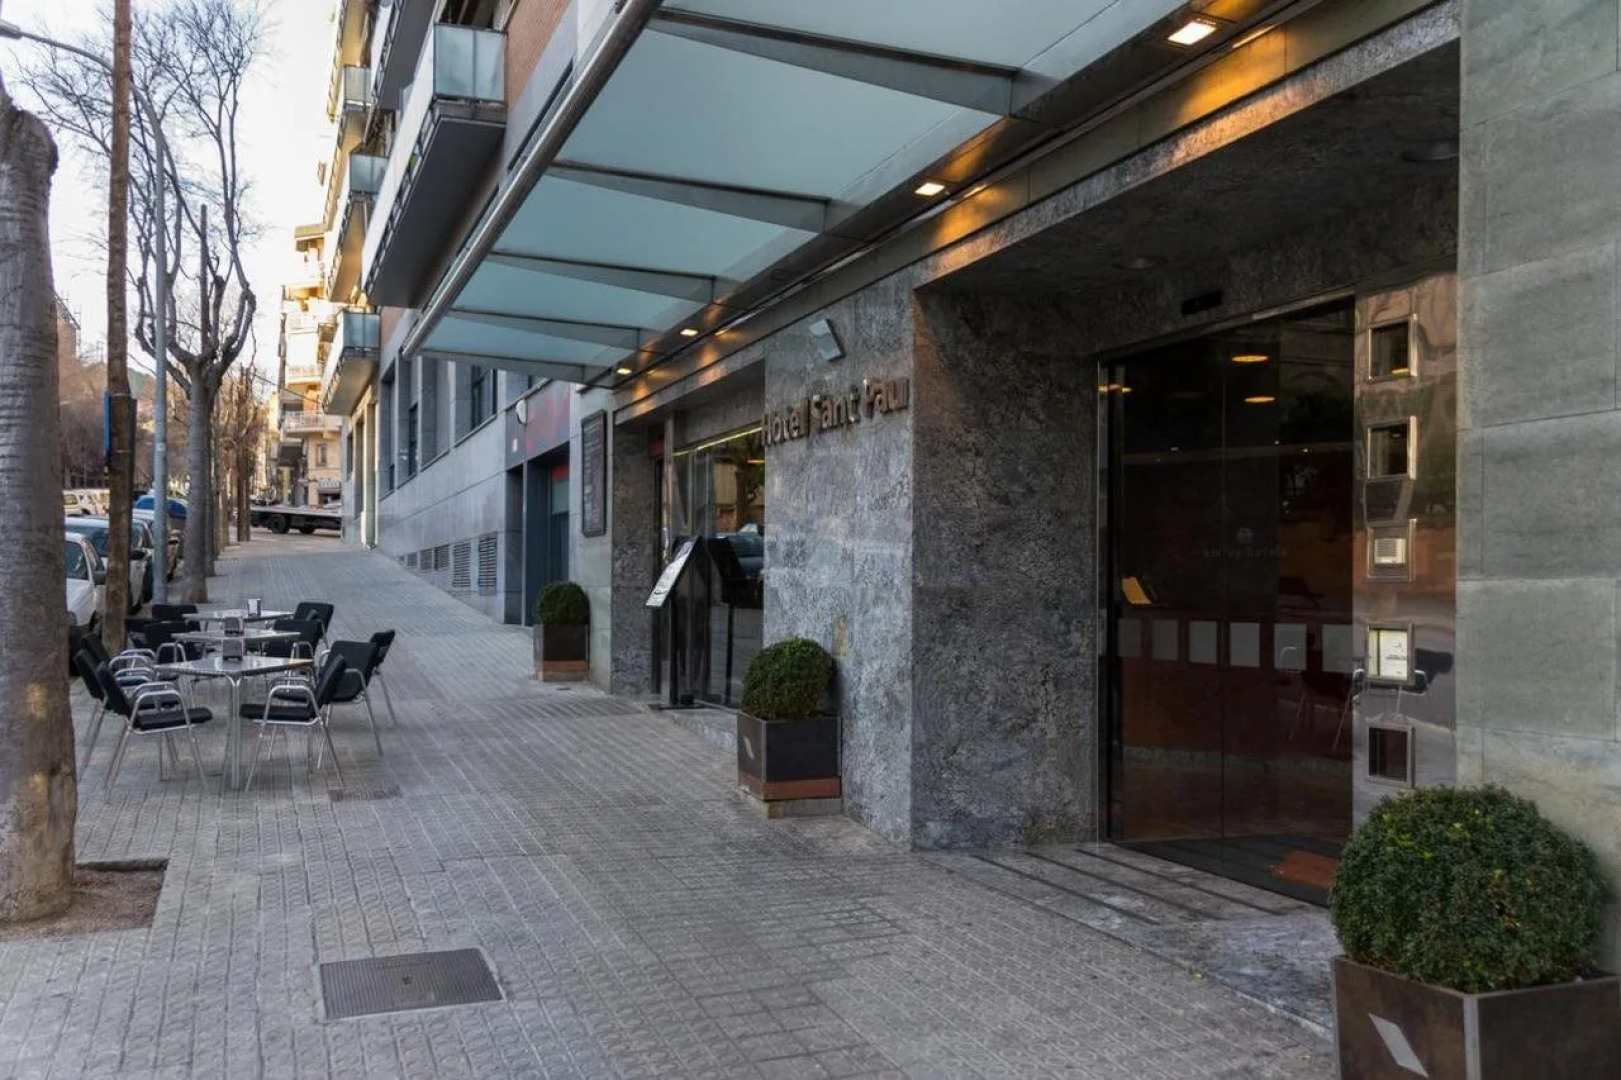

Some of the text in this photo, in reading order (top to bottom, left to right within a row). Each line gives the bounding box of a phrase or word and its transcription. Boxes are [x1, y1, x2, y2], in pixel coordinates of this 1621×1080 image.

[762, 377, 910, 446] Hotel Sant Pau
